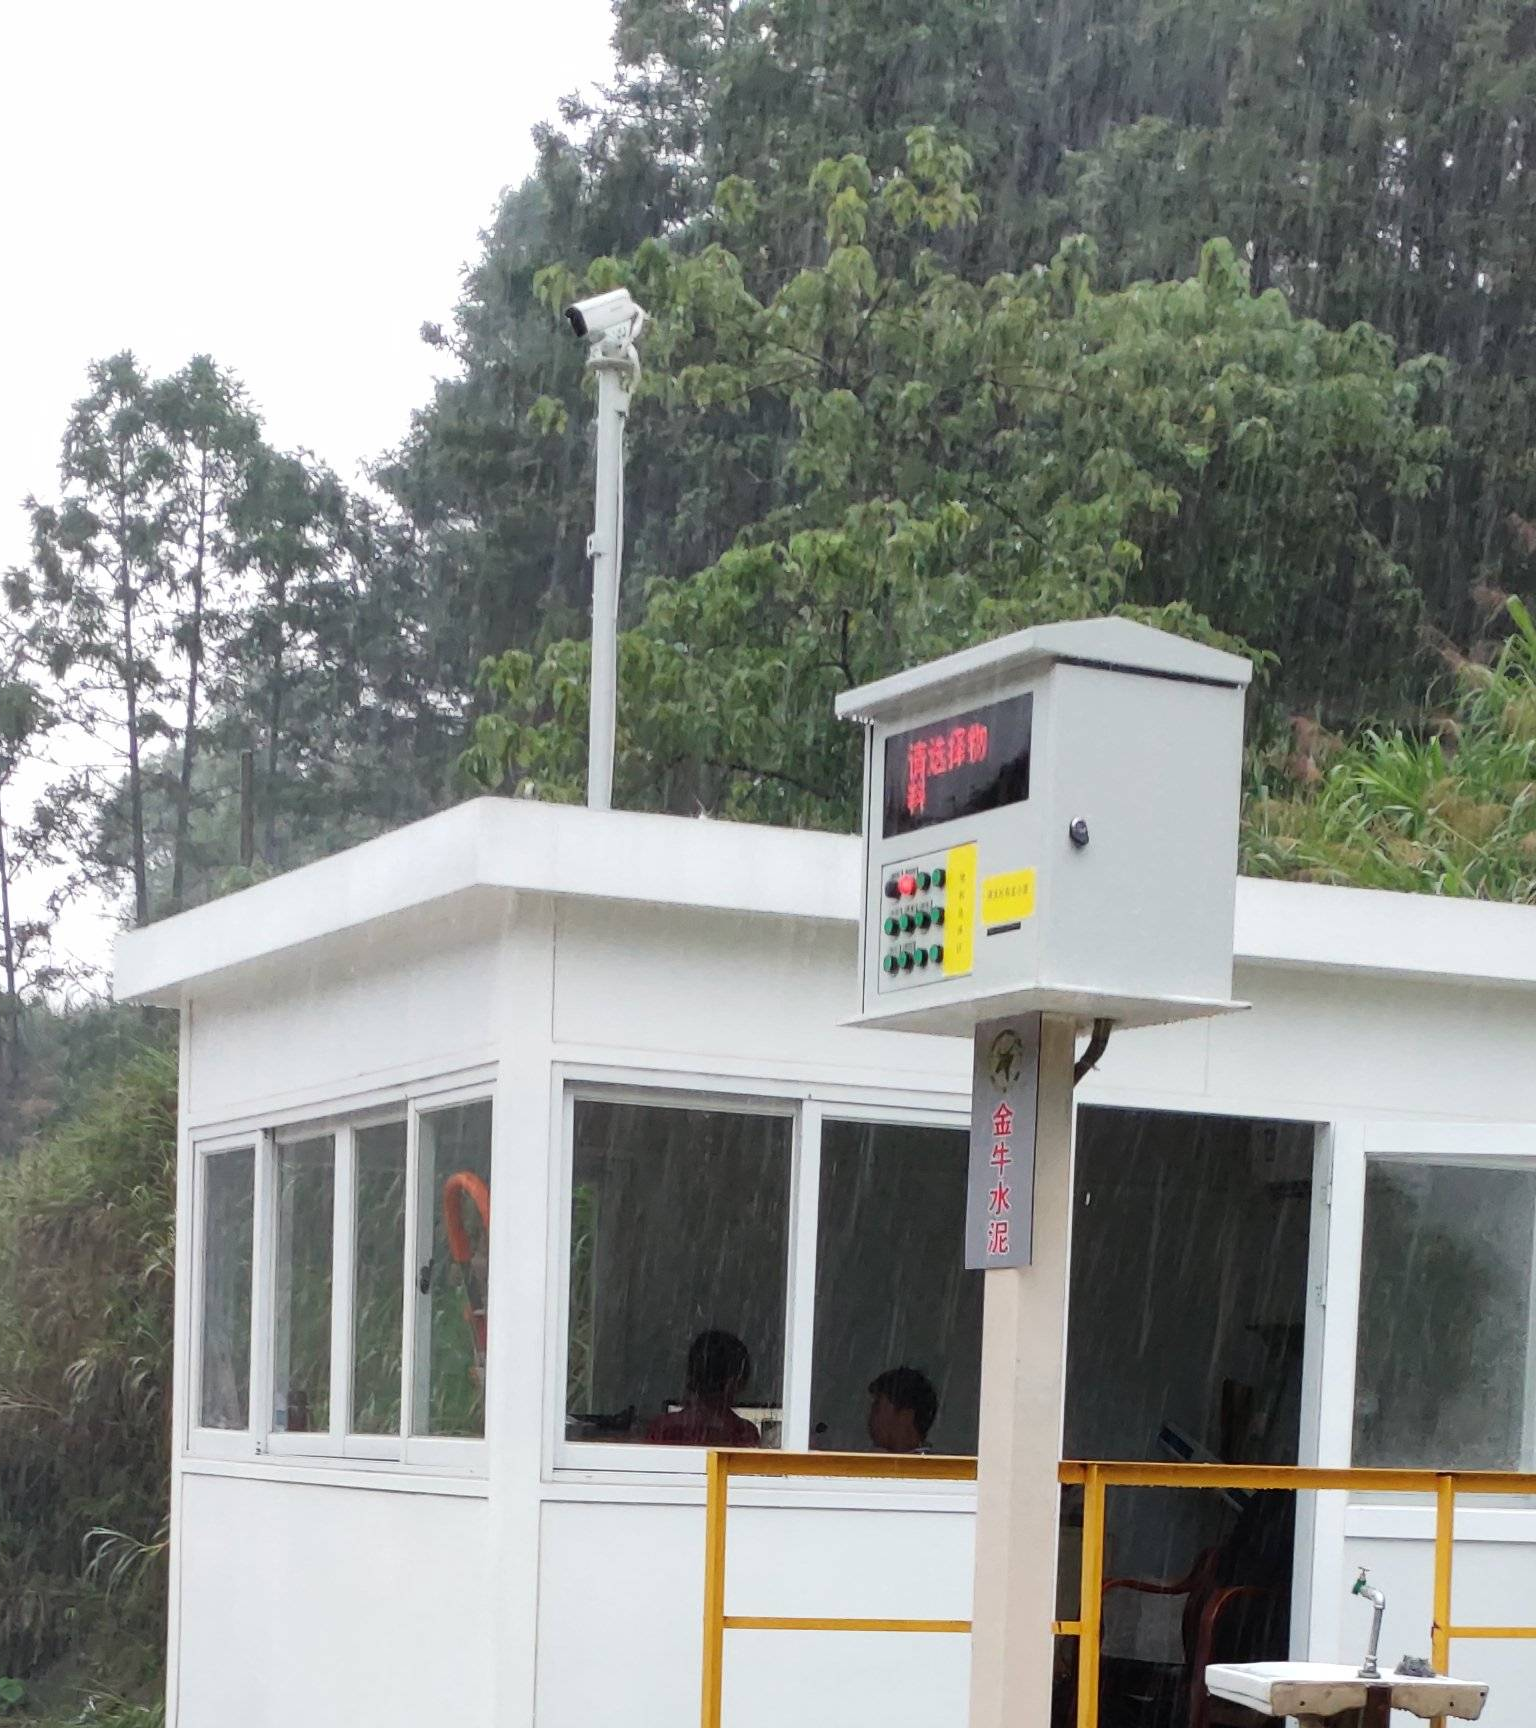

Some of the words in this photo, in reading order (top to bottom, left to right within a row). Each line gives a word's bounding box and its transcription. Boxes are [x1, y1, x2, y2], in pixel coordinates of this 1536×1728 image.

[907, 722, 989, 782] 请选择物
[987, 1102, 1014, 1255] 金牛水泥
